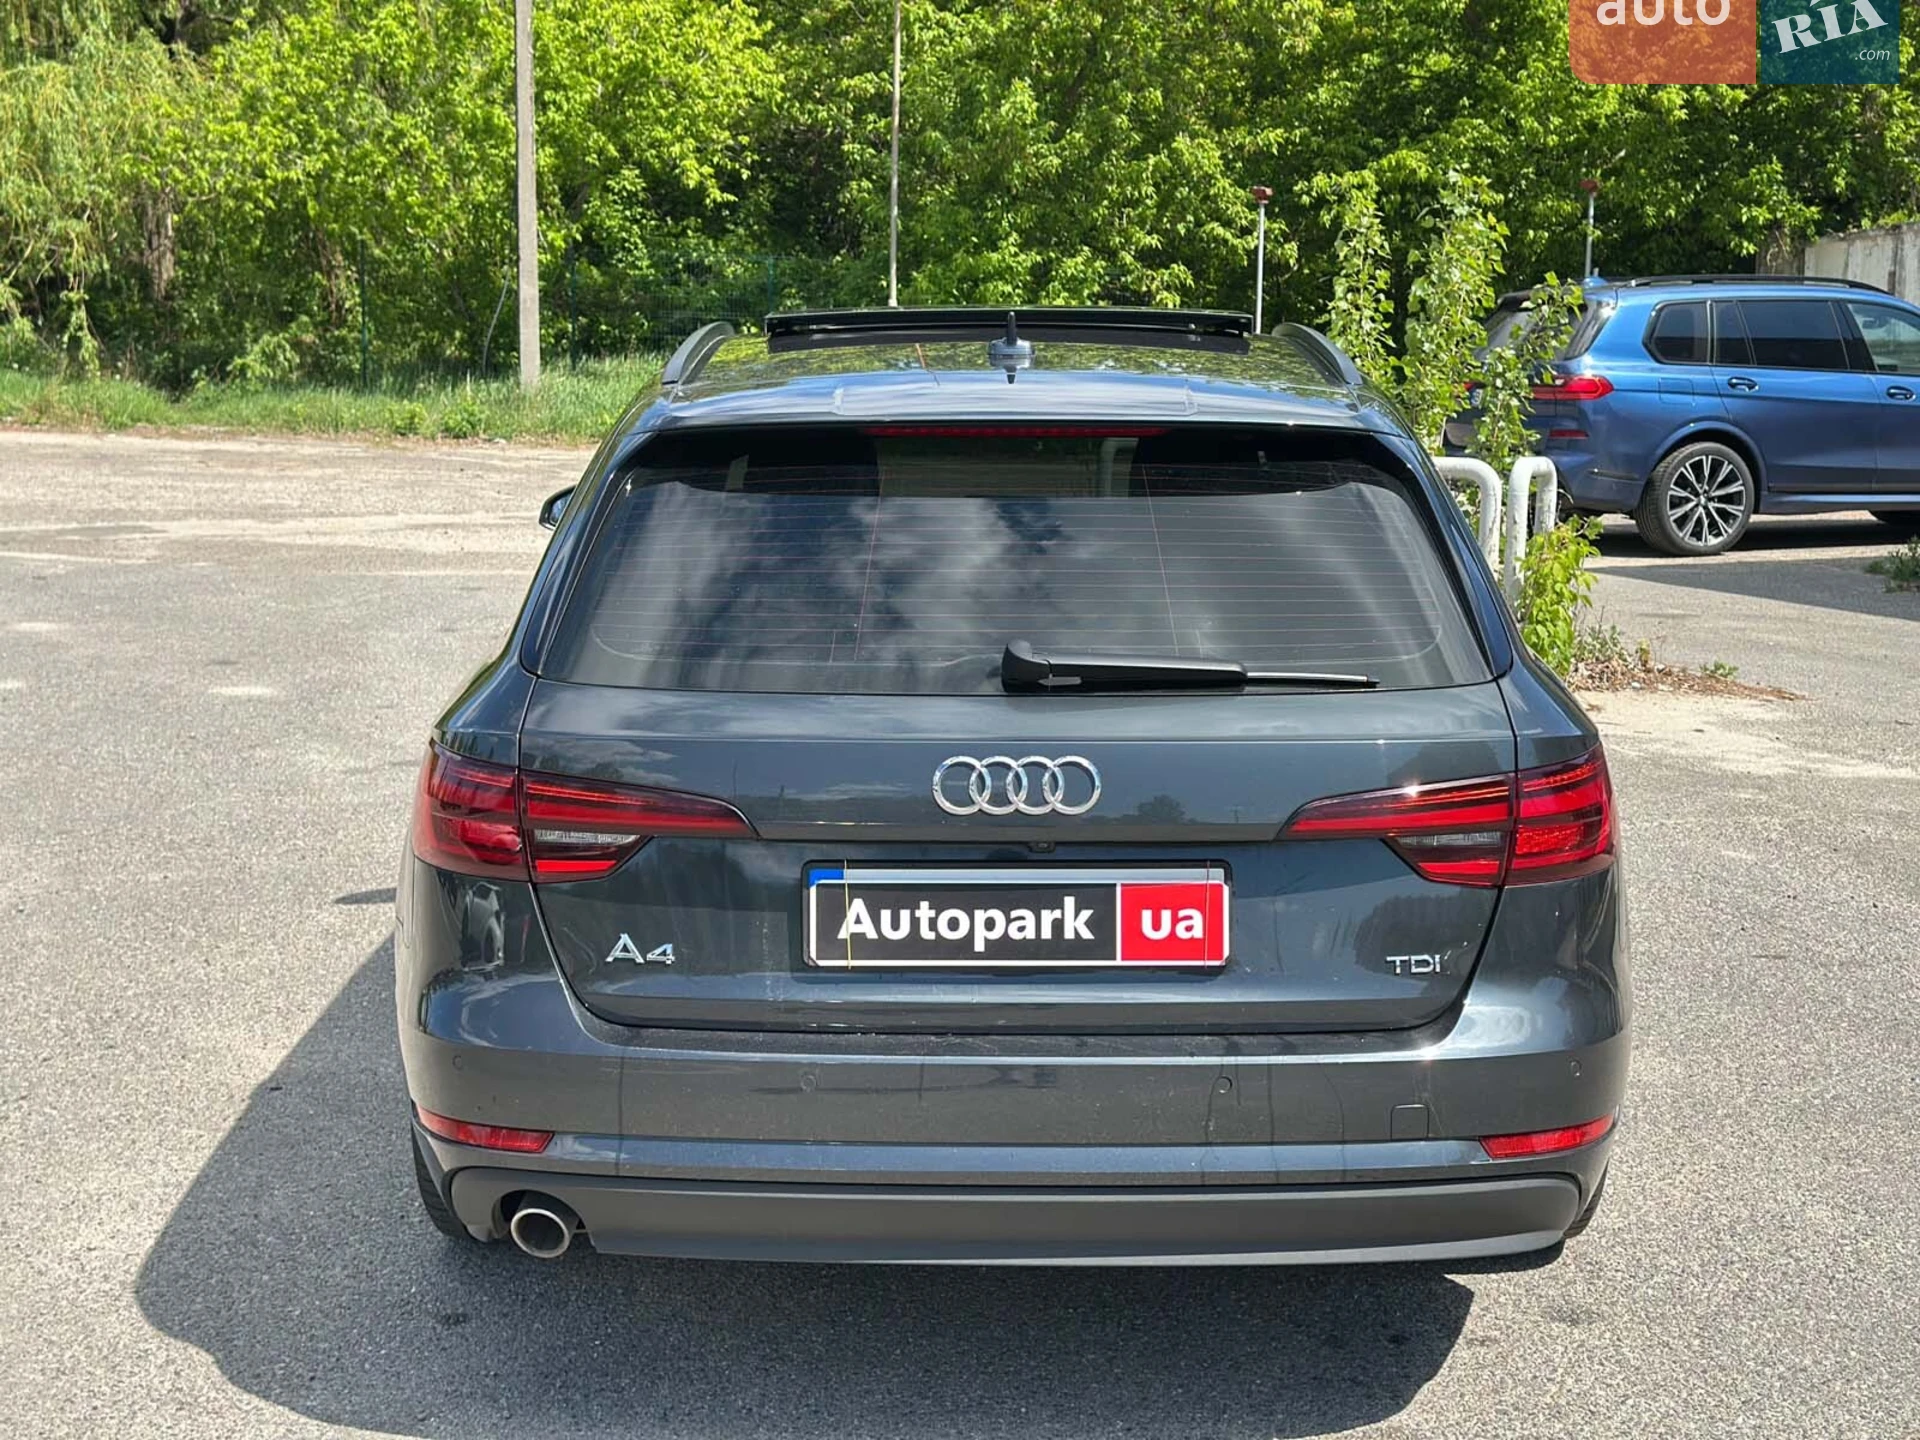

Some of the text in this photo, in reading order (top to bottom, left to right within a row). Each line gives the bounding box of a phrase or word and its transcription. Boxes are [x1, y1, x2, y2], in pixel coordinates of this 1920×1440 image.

[837, 895, 1204, 953] Autopark ua
[605, 932, 676, 965] A4
[1386, 953, 1441, 975] TDI
